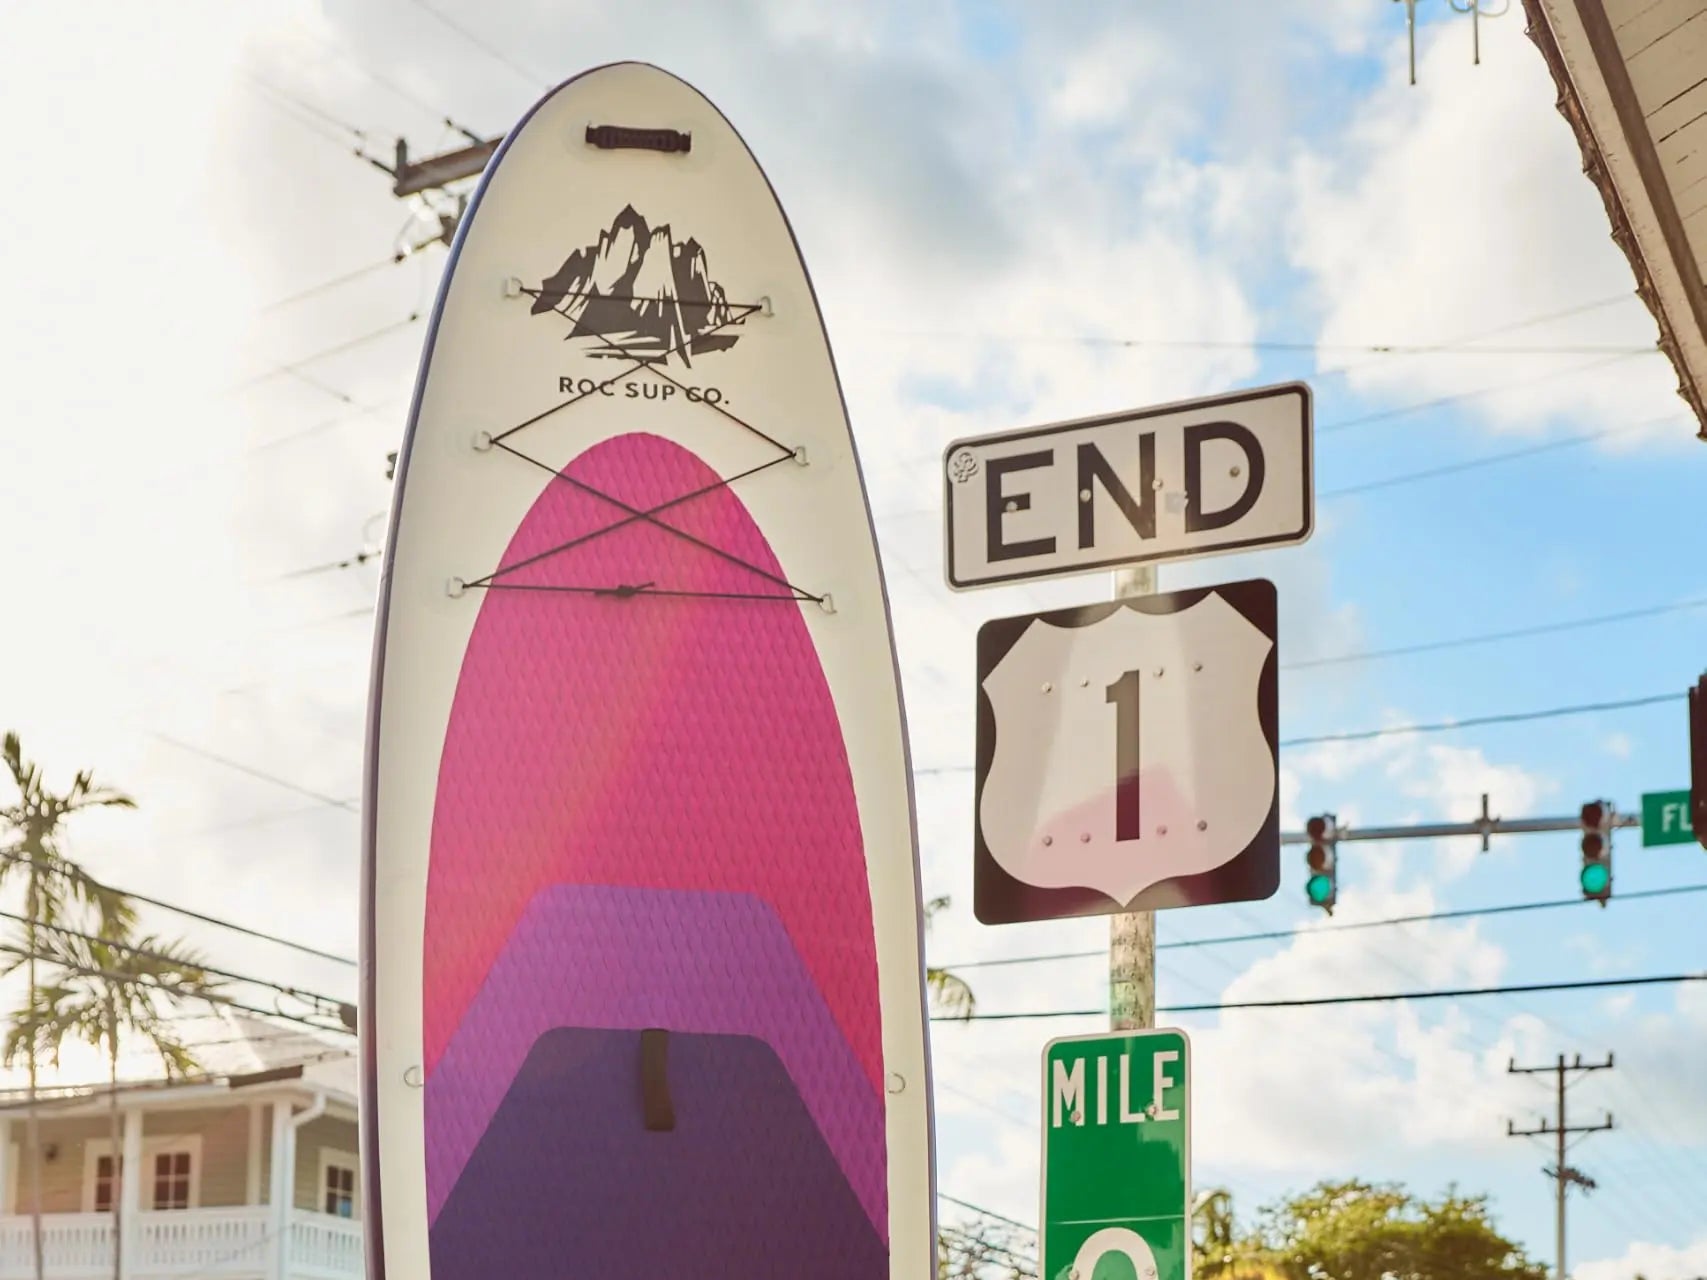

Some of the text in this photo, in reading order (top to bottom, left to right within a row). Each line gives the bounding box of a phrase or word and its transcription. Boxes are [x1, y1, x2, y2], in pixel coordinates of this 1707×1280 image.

[559, 376, 730, 405] ROC SUP CO.
[985, 420, 1266, 564] END
[1105, 668, 1140, 842] 1
[1052, 1050, 1180, 1128] MILE
